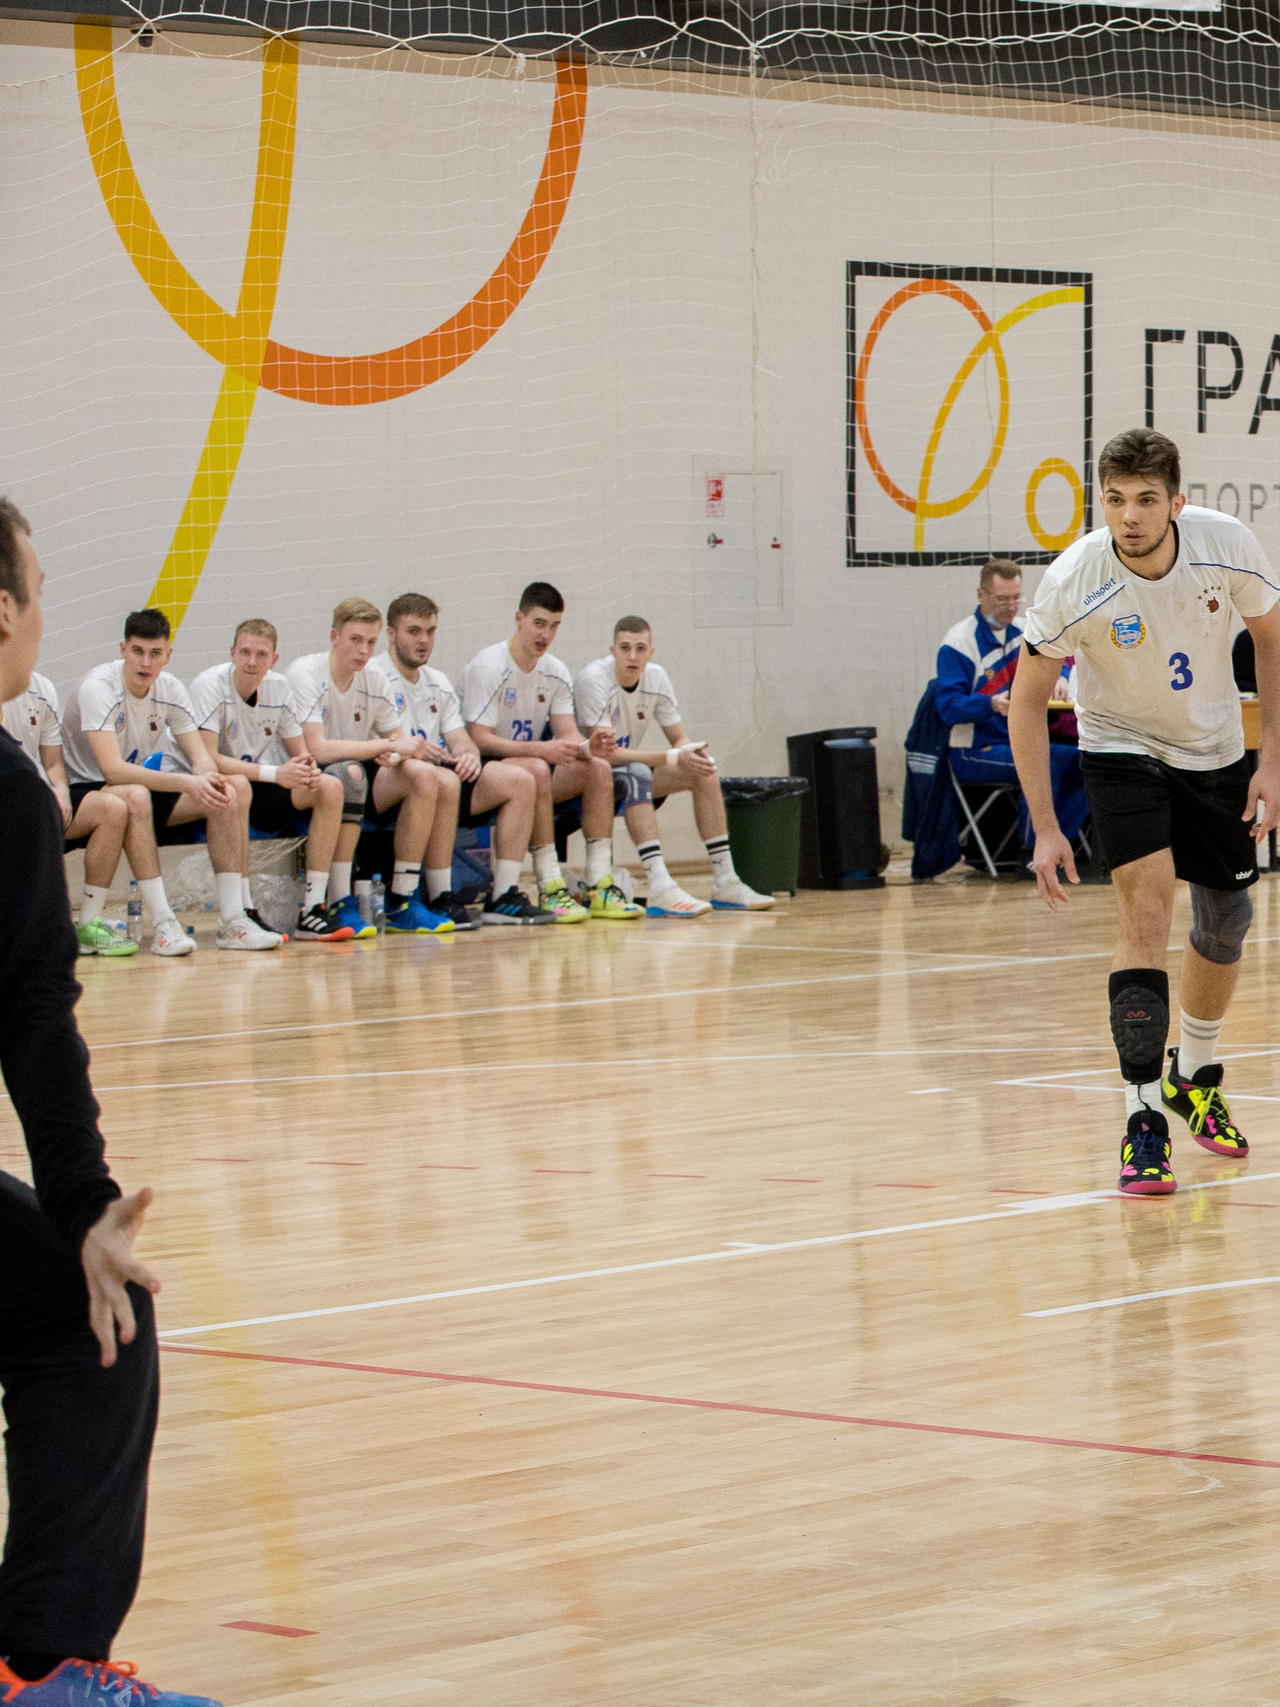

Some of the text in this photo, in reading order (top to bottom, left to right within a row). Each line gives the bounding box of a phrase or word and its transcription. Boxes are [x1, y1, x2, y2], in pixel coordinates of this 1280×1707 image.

[1083, 578, 1117, 606] uhlsport
[1169, 652, 1193, 691] 3
[512, 719, 533, 741] 25
